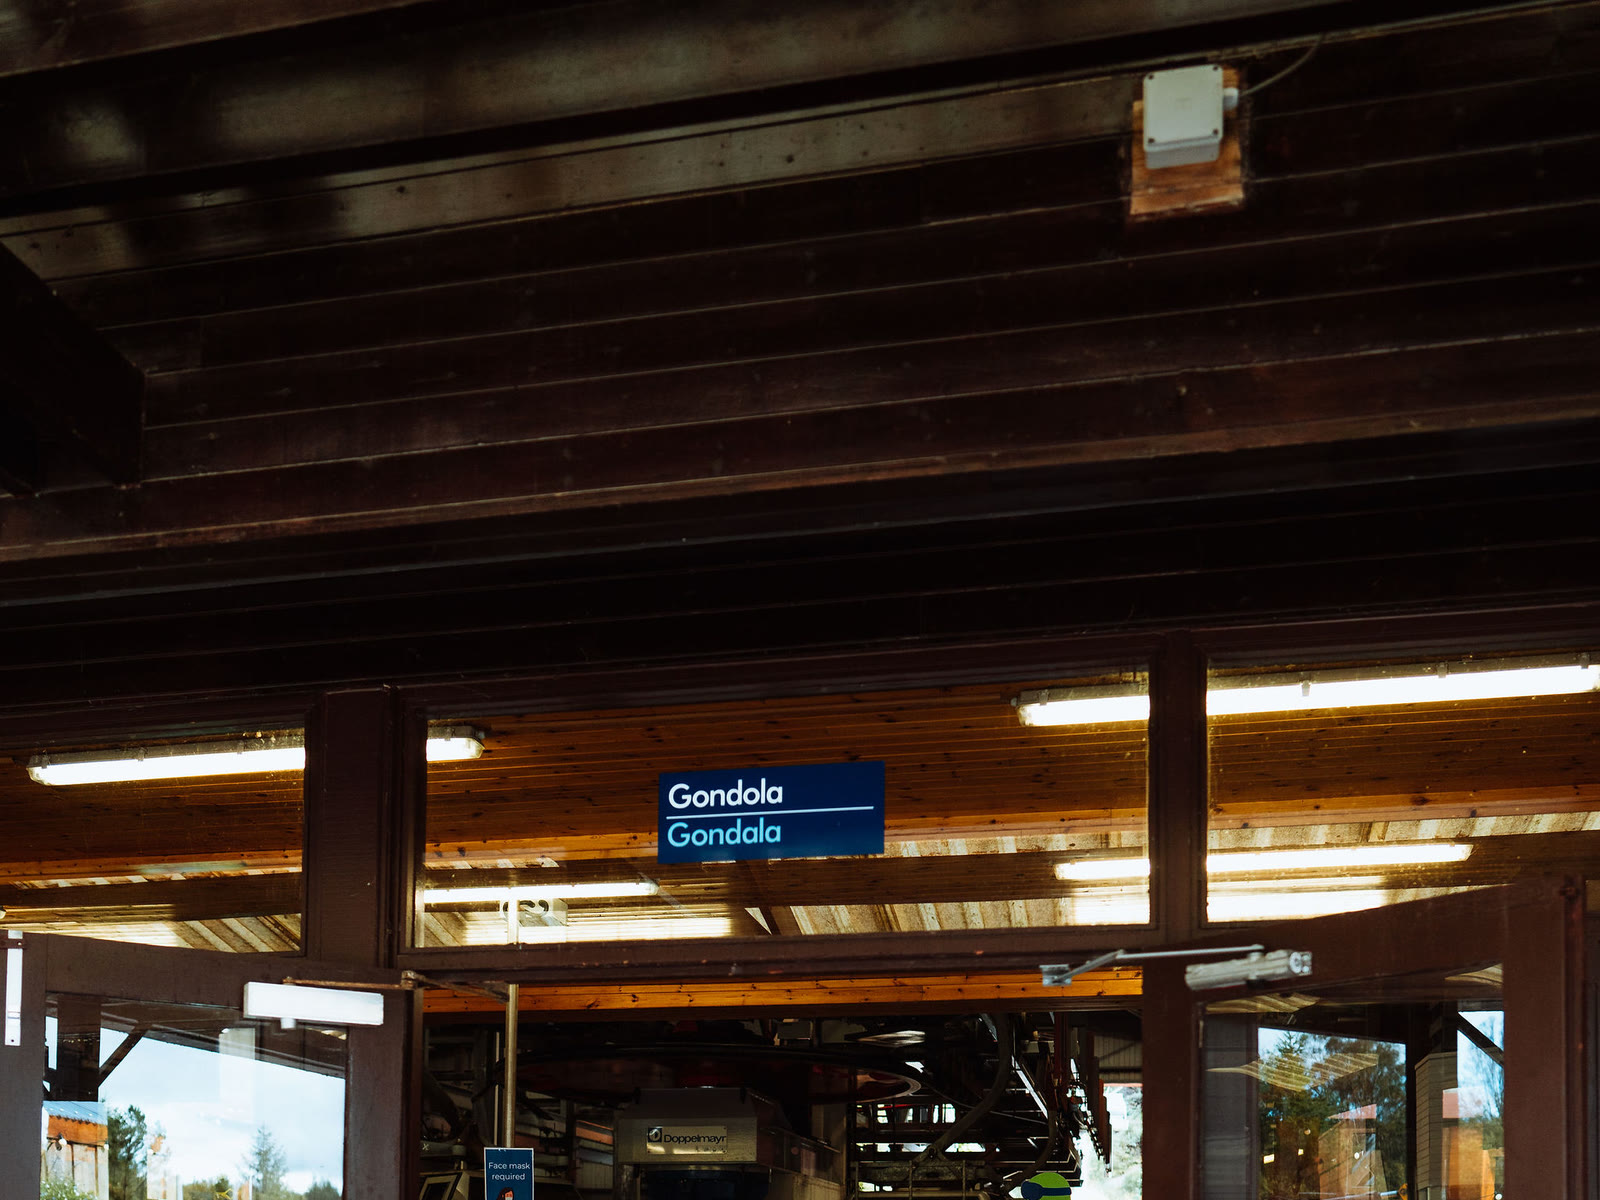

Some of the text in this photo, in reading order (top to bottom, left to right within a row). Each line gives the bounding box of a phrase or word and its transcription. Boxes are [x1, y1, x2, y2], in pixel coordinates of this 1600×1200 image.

[668, 777, 783, 809] Gondola
[667, 816, 781, 847] Gondala
[664, 1134, 726, 1144] Doppelmayr
[488, 1162, 531, 1170] Face mask
[491, 1173, 526, 1181] required
